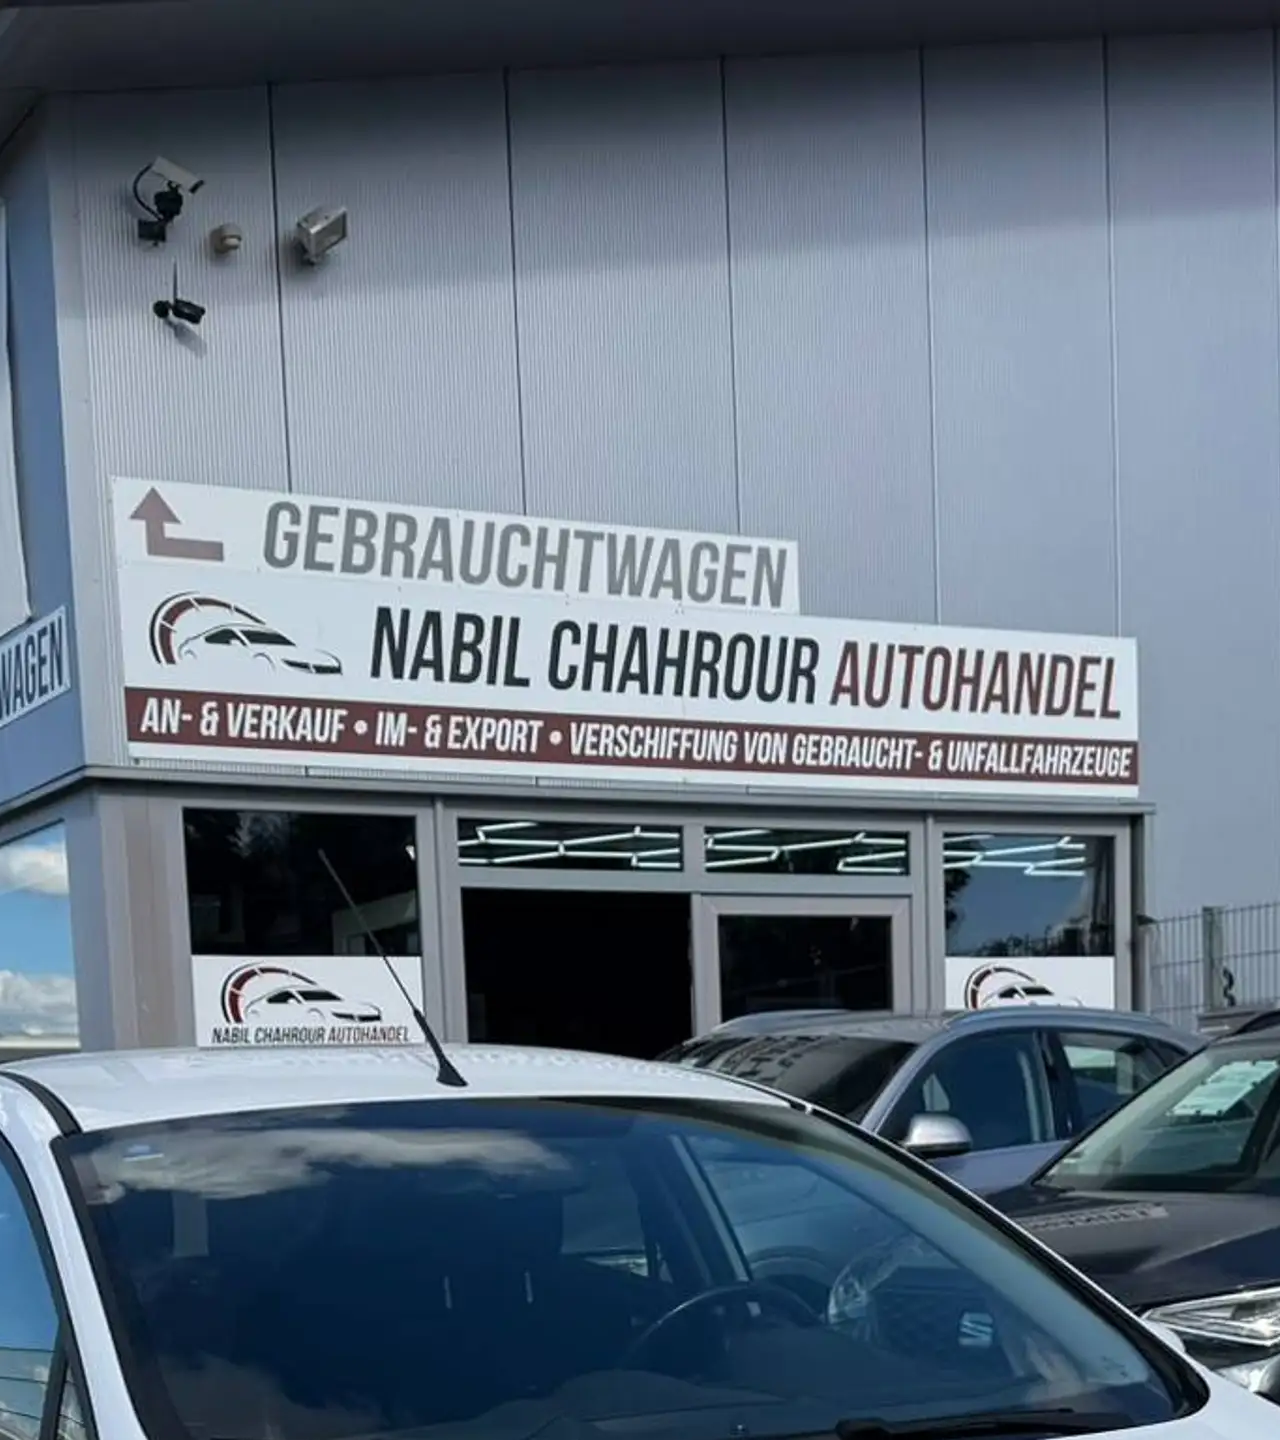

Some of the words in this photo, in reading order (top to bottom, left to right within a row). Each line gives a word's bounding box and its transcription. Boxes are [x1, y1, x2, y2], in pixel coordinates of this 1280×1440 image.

[263, 500, 788, 608] GEBRAUCHTWAGEN
[370, 605, 531, 689] NABIL
[548, 619, 820, 704] CHAHROUR
[829, 640, 1122, 719] AUTOHANDEL
[140, 697, 193, 735] AN-
[199, 701, 220, 738] &
[226, 702, 348, 744] VERKAUF
[375, 711, 418, 748] IM-
[424, 714, 442, 748] &
[447, 715, 544, 754] EXPORT
[569, 721, 738, 762] VERSCHIFFUNG
[743, 730, 788, 765] VON
[792, 733, 923, 771] GEBRAUCHT-
[928, 739, 943, 772] &
[947, 742, 1132, 778] UNFALLFAHRZEUGE
[211, 1026, 251, 1044] NABIL
[253, 1026, 325, 1044] CHAHROUR
[327, 1025, 410, 1043] AUTOHANDEL
